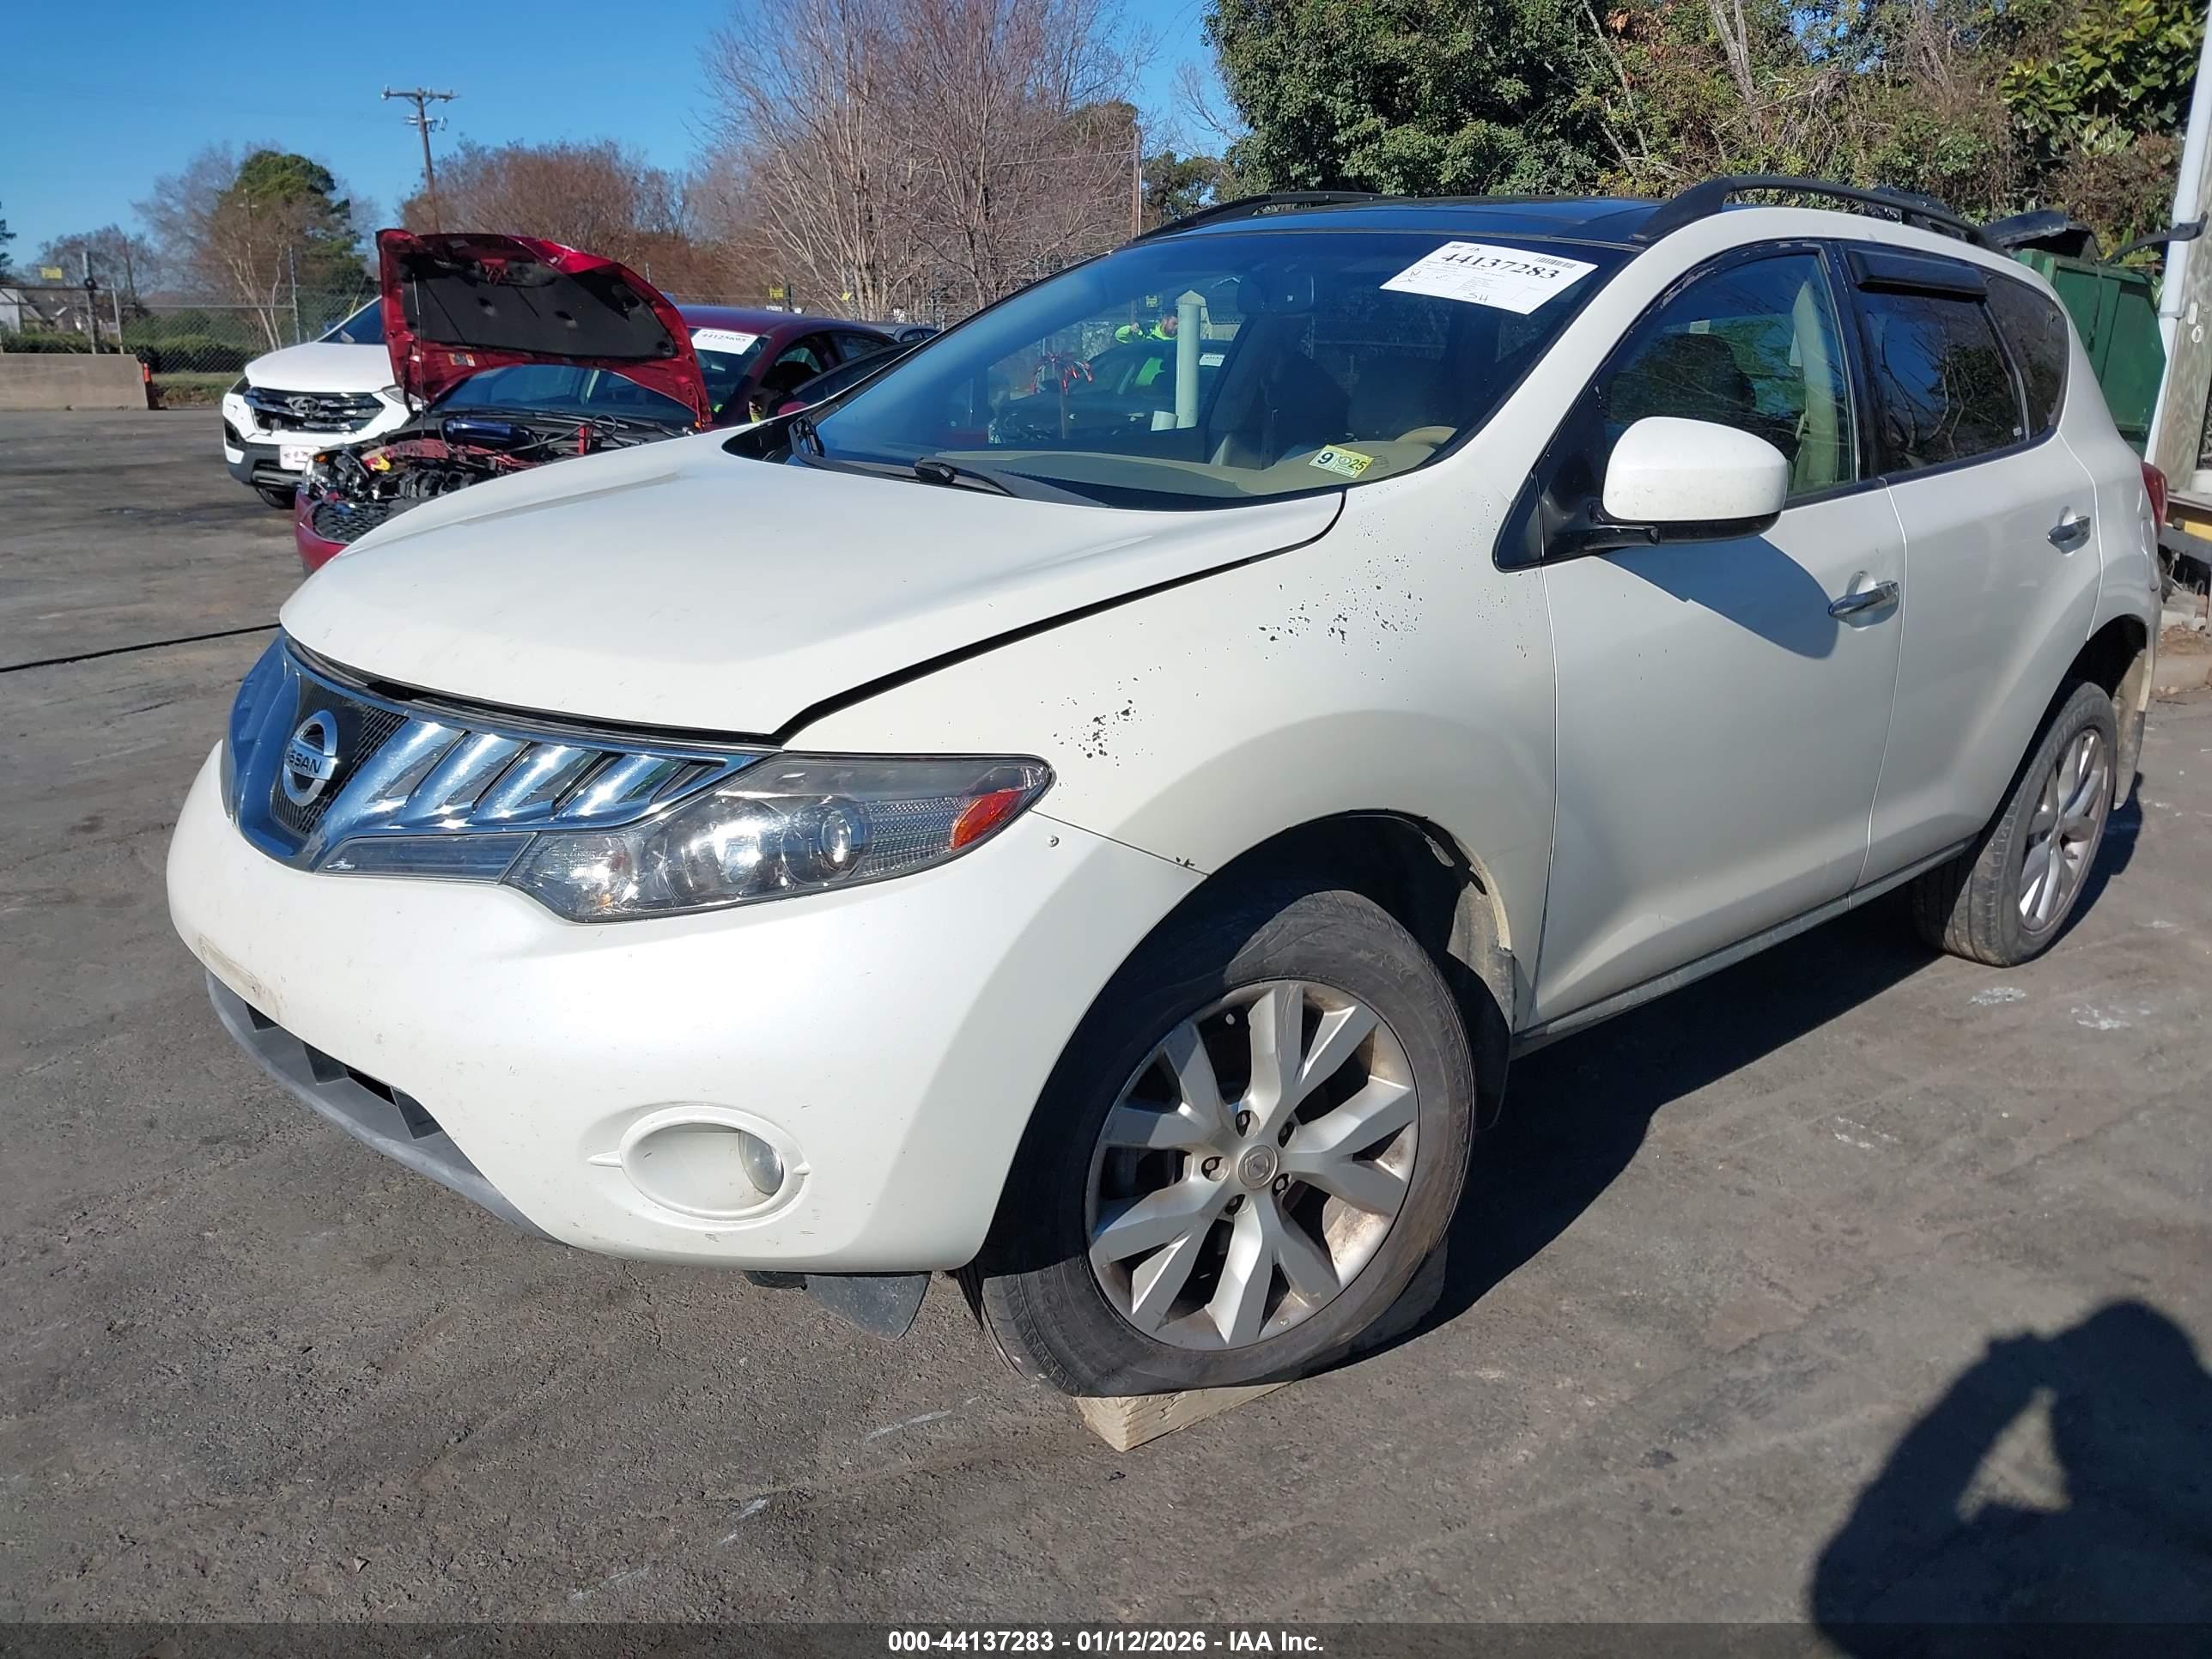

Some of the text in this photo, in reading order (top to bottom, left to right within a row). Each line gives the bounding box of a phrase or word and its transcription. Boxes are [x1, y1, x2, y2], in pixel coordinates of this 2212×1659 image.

[1442, 252, 1560, 279] 44137283
[1317, 452, 1367, 471] 9 25
[287, 749, 322, 774] SSAN
